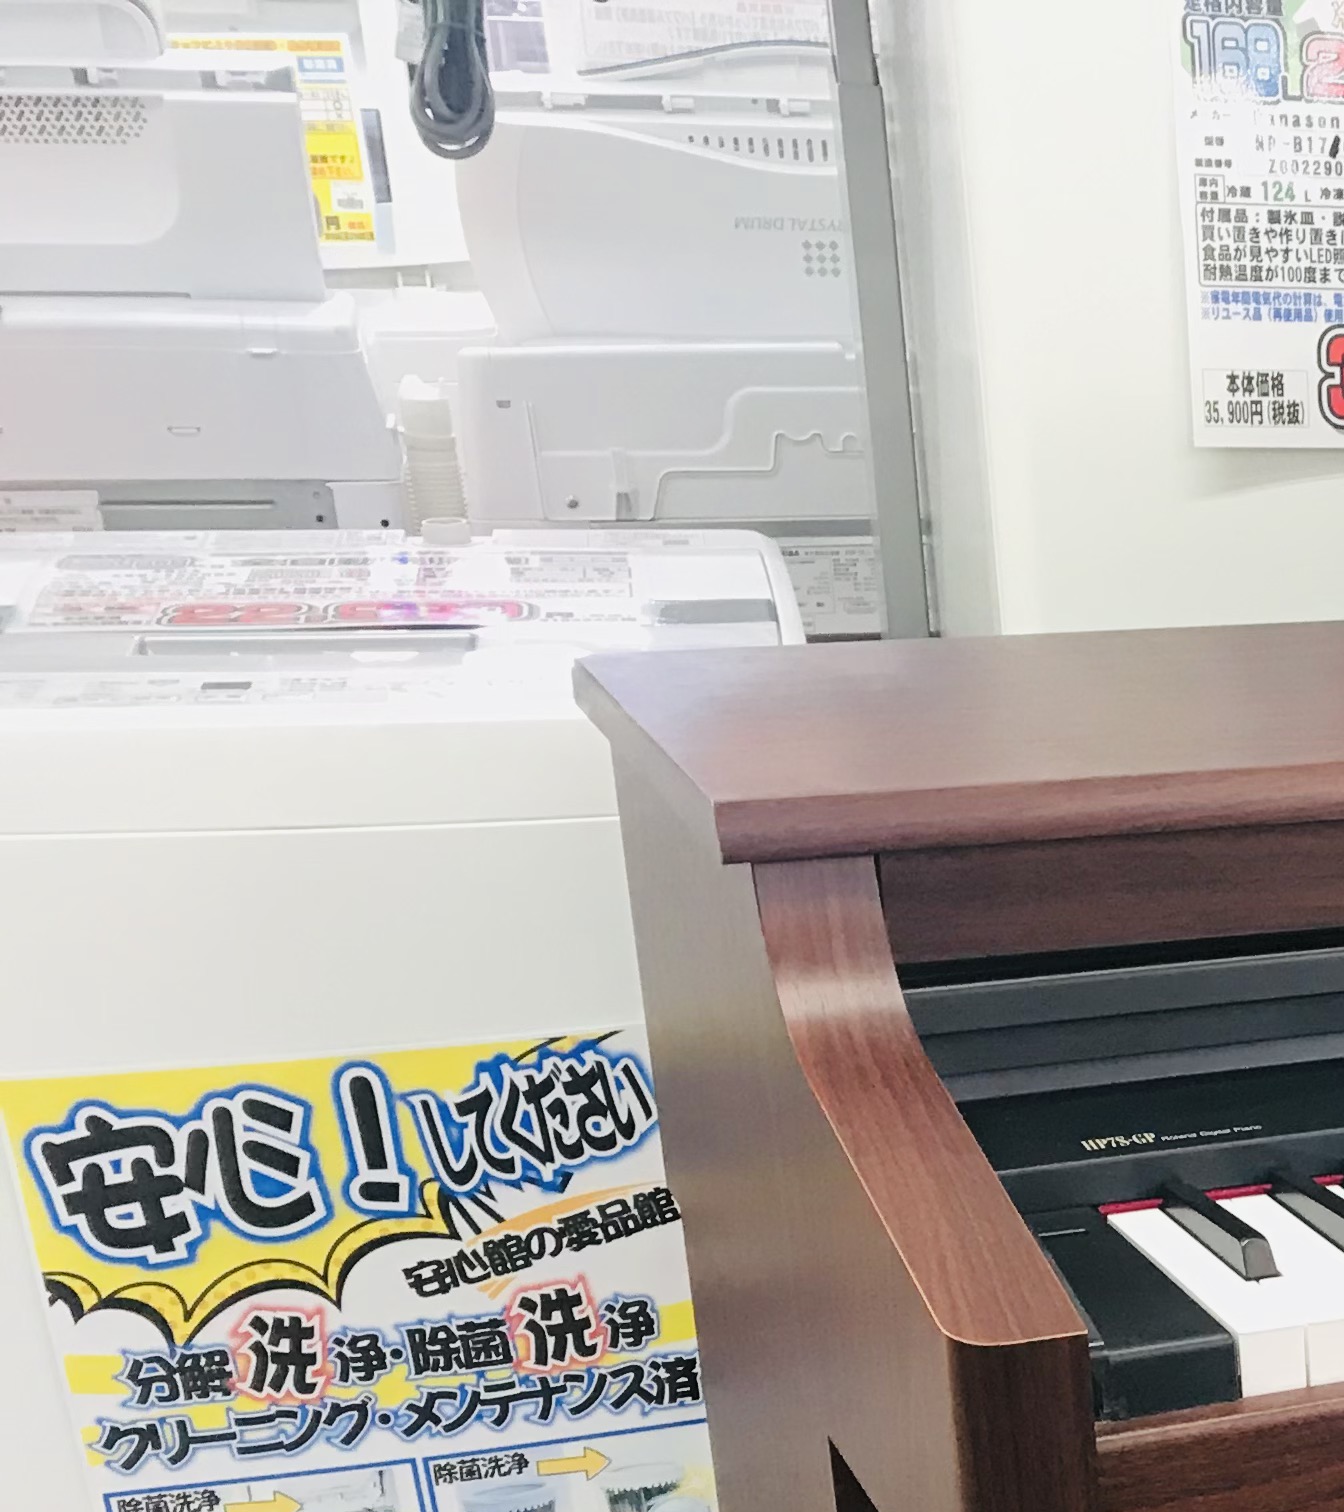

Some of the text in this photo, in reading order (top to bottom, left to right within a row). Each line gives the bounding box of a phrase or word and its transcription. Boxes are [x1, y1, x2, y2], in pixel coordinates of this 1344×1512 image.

[1261, 180, 1296, 202] 124
[1226, 371, 1285, 398] 本体価格
[1232, 1124, 1263, 1133] Piano
[402, 1187, 682, 1298] 安心館の愛品館
[127, 1288, 655, 1405] 分解洗浄・除菌洗浄
[102, 1356, 701, 1471] クリーニング・メンテナンス済
[433, 1451, 529, 1486] 除菌洗浄
